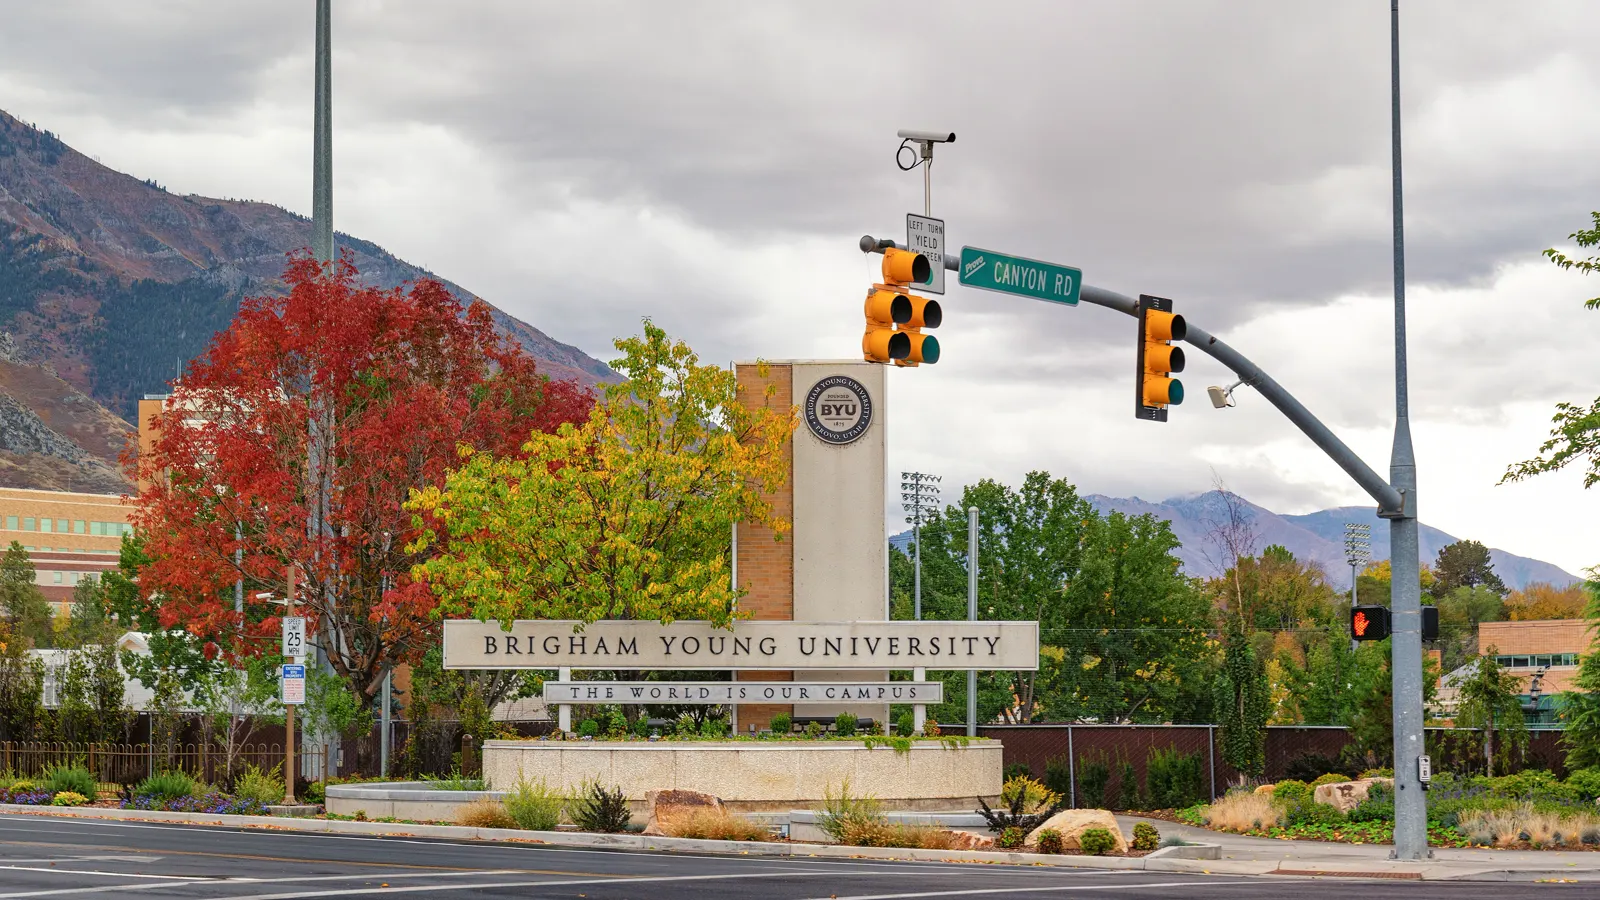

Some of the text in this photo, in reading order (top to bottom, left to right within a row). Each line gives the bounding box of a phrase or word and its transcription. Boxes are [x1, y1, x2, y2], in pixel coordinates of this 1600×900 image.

[909, 220, 943, 235] LEFT TURN
[916, 234, 938, 249] YIELD
[965, 255, 984, 273] Provo
[993, 261, 1073, 296] CANYON RD
[807, 378, 870, 420] BRIGHAM YOUNG UNIVERSITY
[821, 404, 857, 416] BYU
[842, 425, 863, 439] UTAH
[287, 631, 301, 647] 25
[484, 636, 1001, 656] BRIGHAM YOUNG UNIVERSITY
[288, 647, 300, 655] MPH
[570, 687, 918, 699] THE WORLD IS OUR CAMPUS
